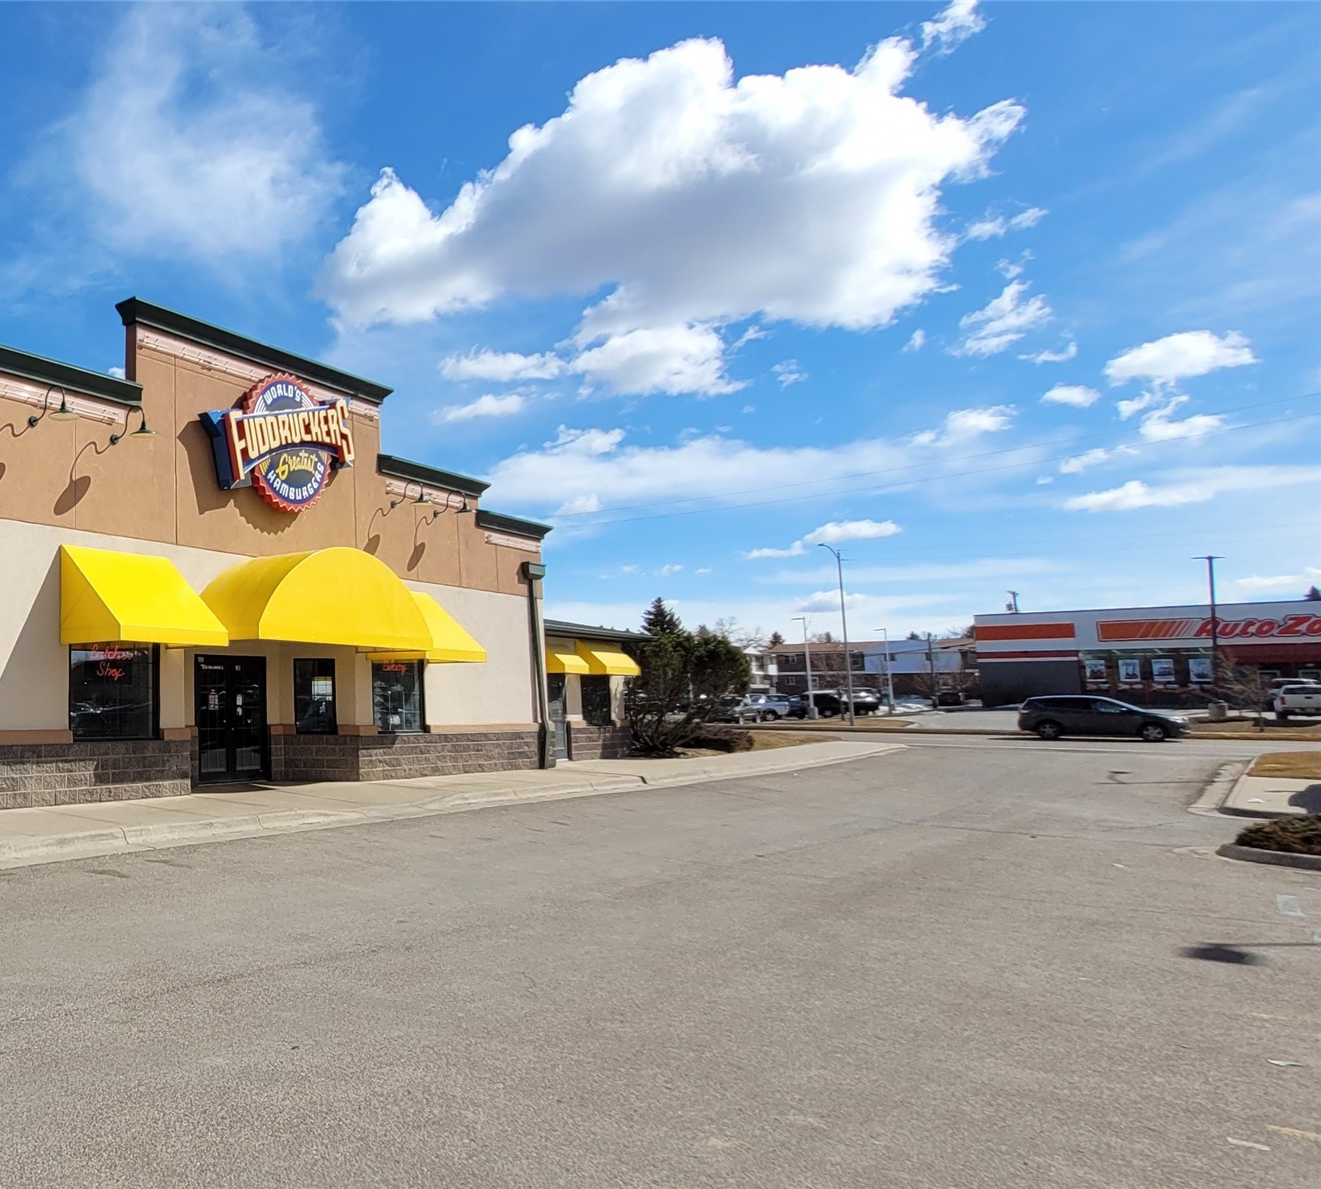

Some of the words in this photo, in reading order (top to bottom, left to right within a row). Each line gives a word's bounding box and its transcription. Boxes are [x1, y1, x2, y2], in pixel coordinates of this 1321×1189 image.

[264, 384, 302, 405] WORLD'S
[230, 398, 355, 480] FUDDRUCKERS
[267, 462, 325, 500] HAMBURGERS
